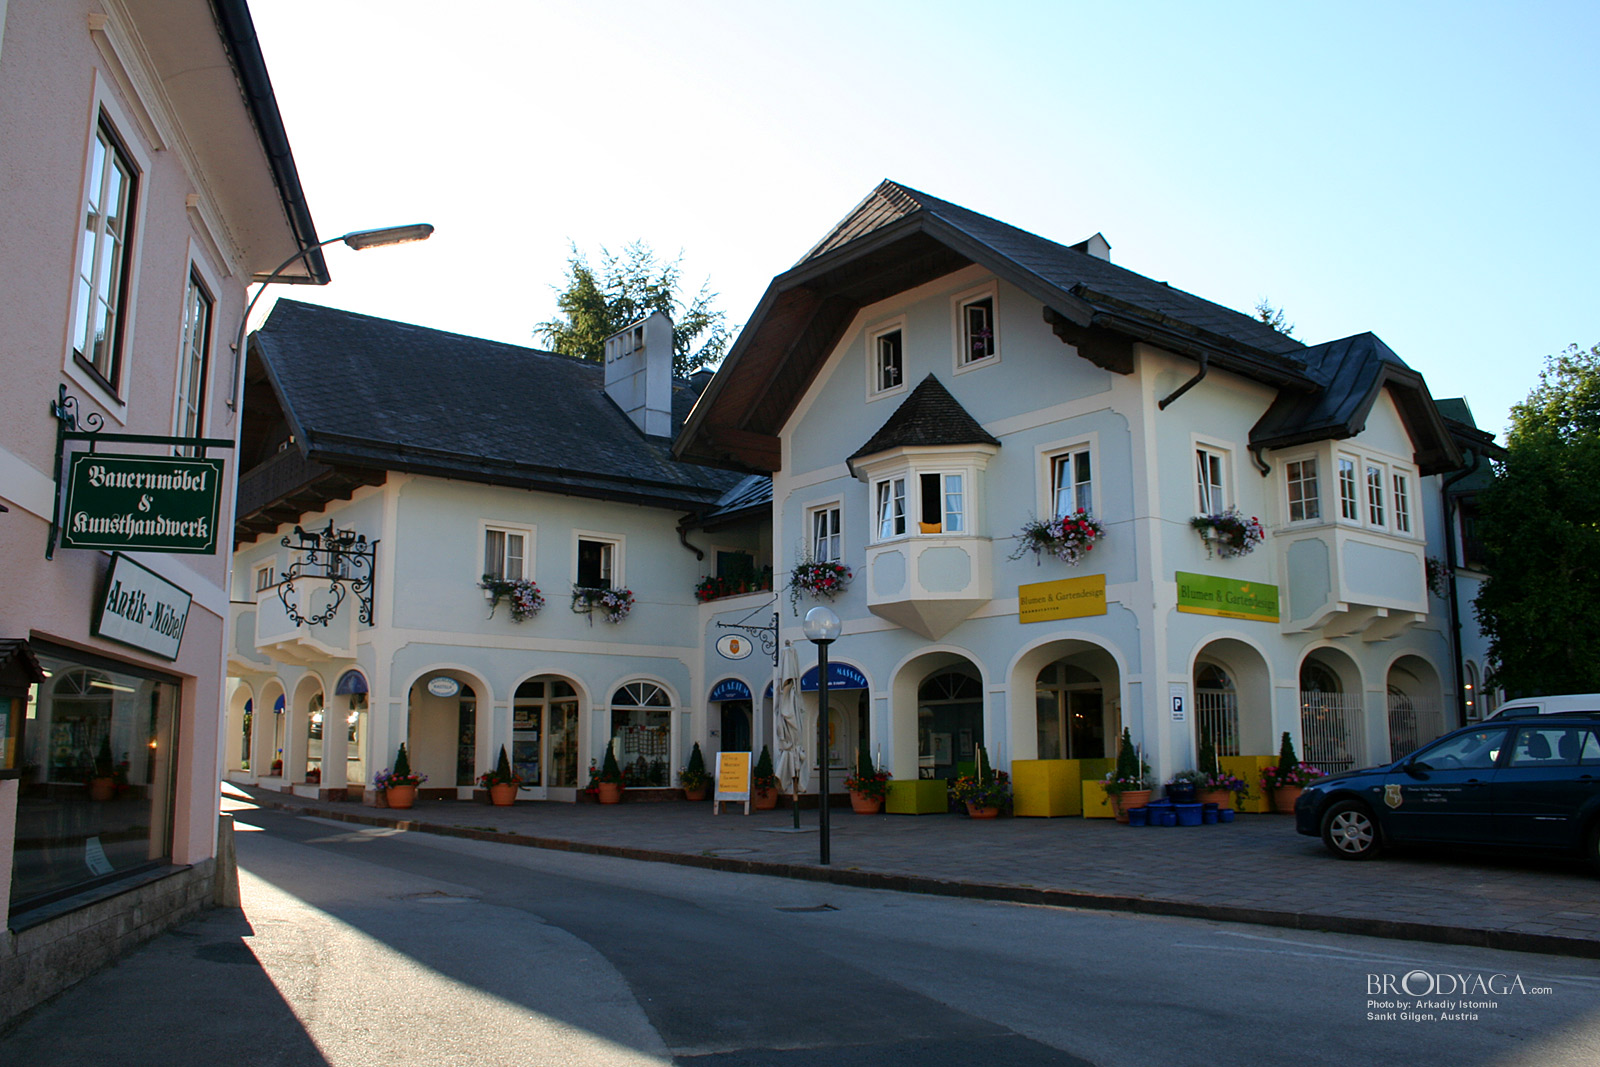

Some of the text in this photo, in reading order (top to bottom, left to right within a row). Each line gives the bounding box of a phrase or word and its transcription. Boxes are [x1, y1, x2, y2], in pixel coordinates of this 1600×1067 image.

[88, 465, 208, 492] Bauernmöbel
[138, 493, 154, 513] &
[72, 510, 208, 541] Kunsthandwerk
[1020, 589, 1104, 606] Blumen & Gartendesign
[1181, 585, 1214, 601] Blumen
[1216, 589, 1223, 603] &
[836, 667, 866, 686] MASSAGE
